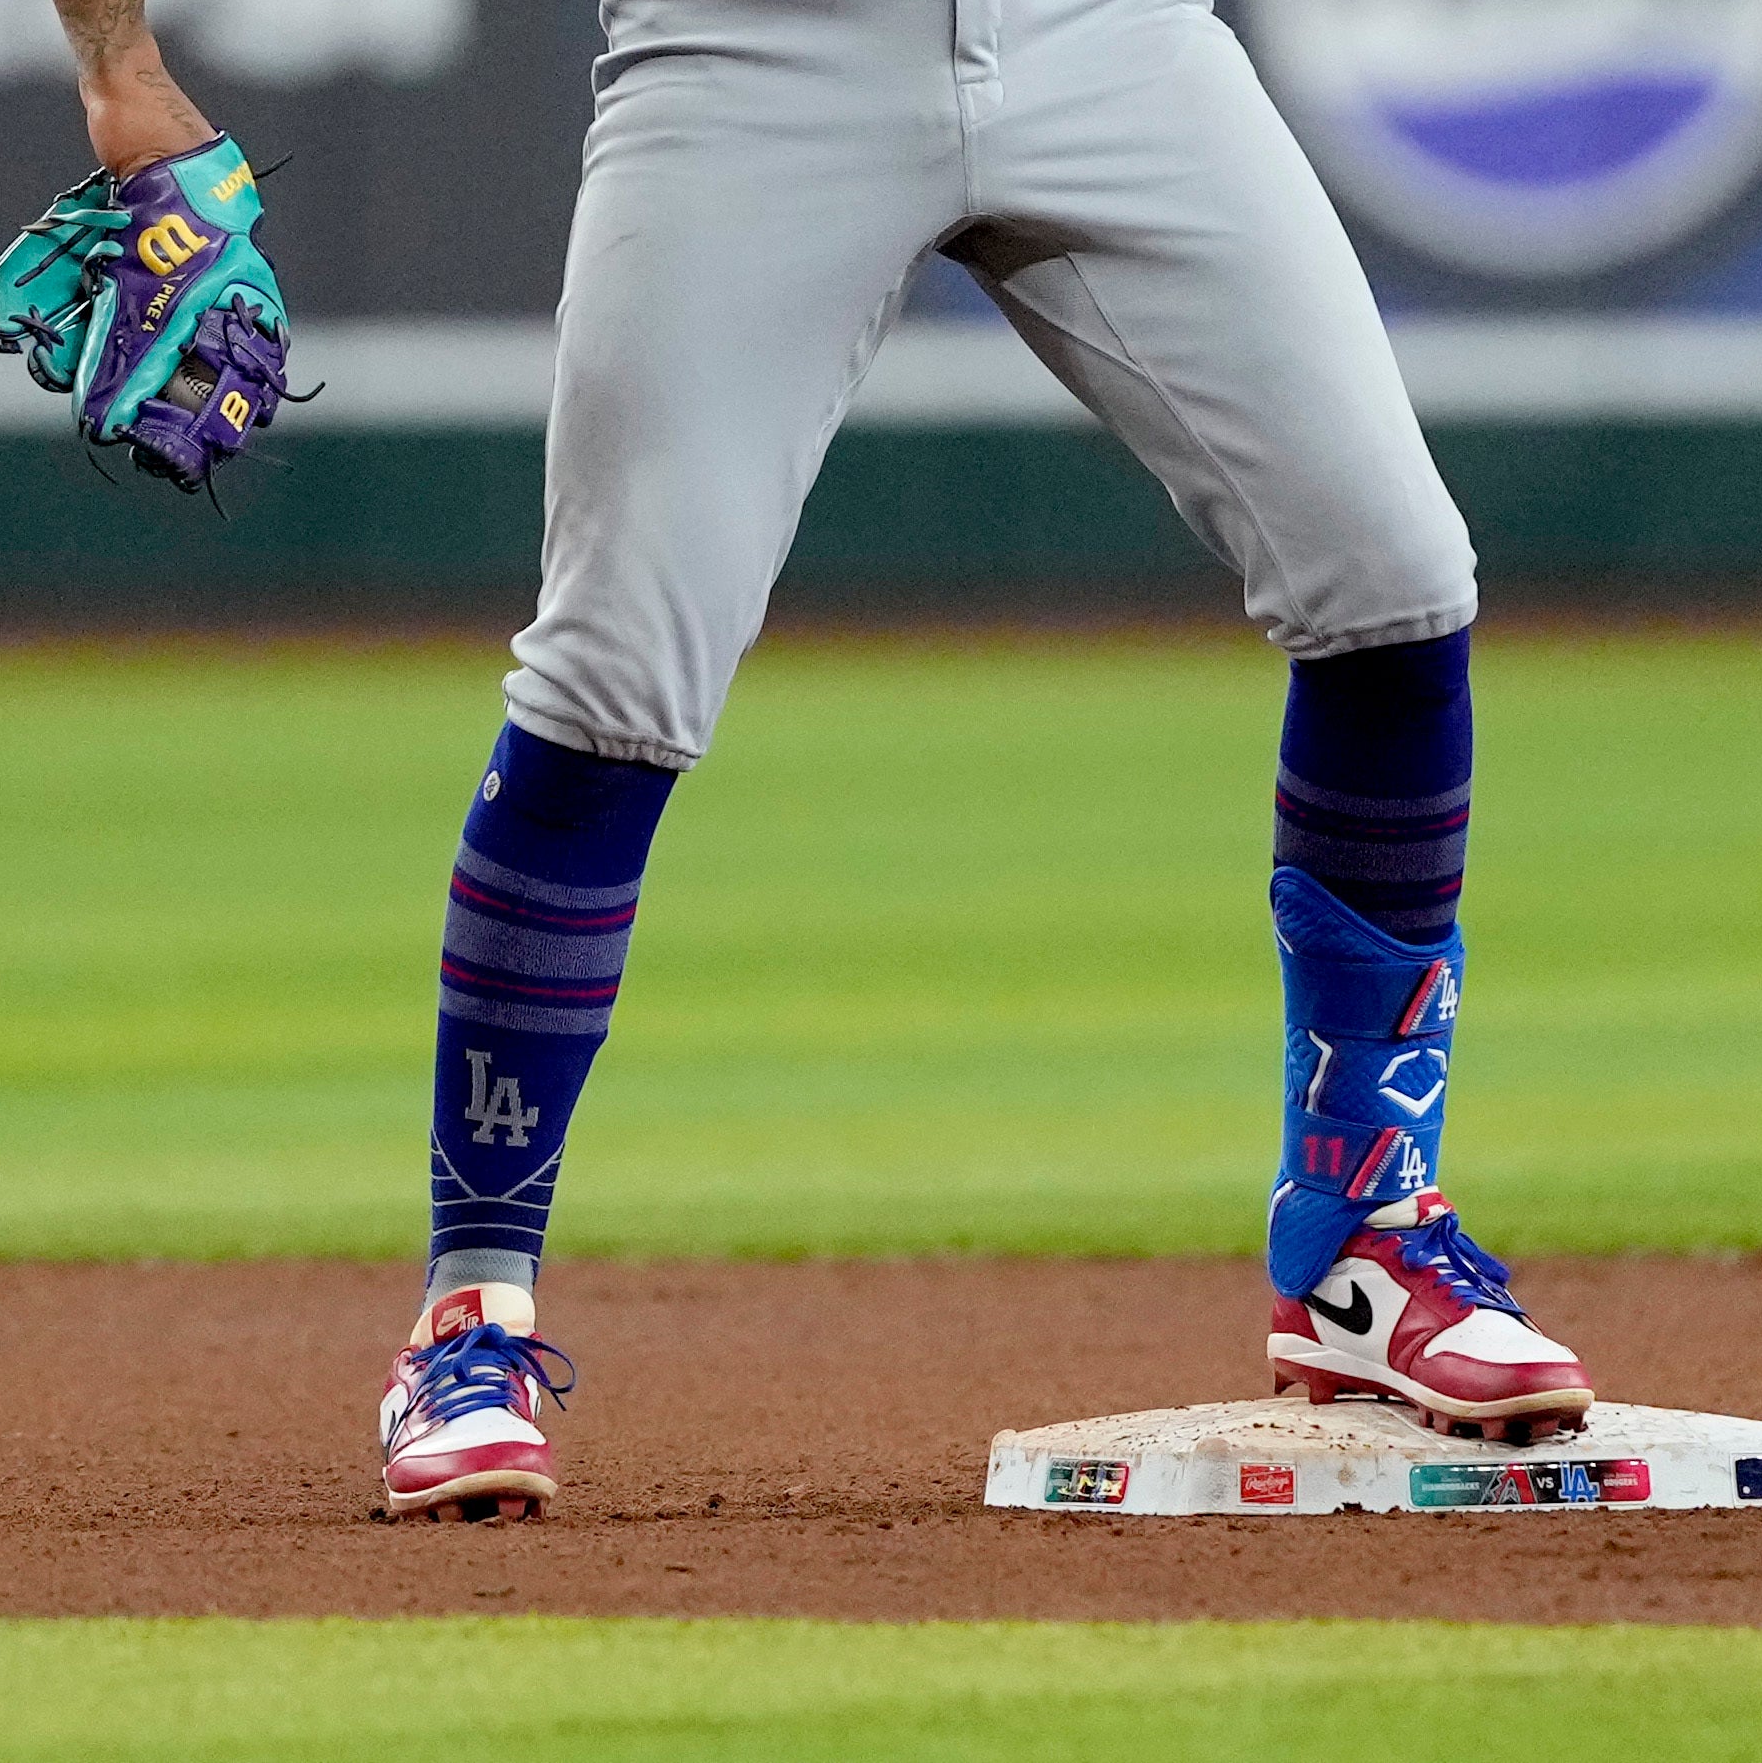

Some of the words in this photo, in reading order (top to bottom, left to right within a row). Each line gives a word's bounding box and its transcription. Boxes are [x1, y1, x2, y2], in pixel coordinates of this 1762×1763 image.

[146, 283, 176, 319] PIKE
[1437, 967, 1459, 1021] LA
[464, 1048, 540, 1147] LA
[1303, 1135, 1344, 1177] 11
[1398, 1136, 1427, 1189] LA
[458, 1315, 480, 1332] AIR
